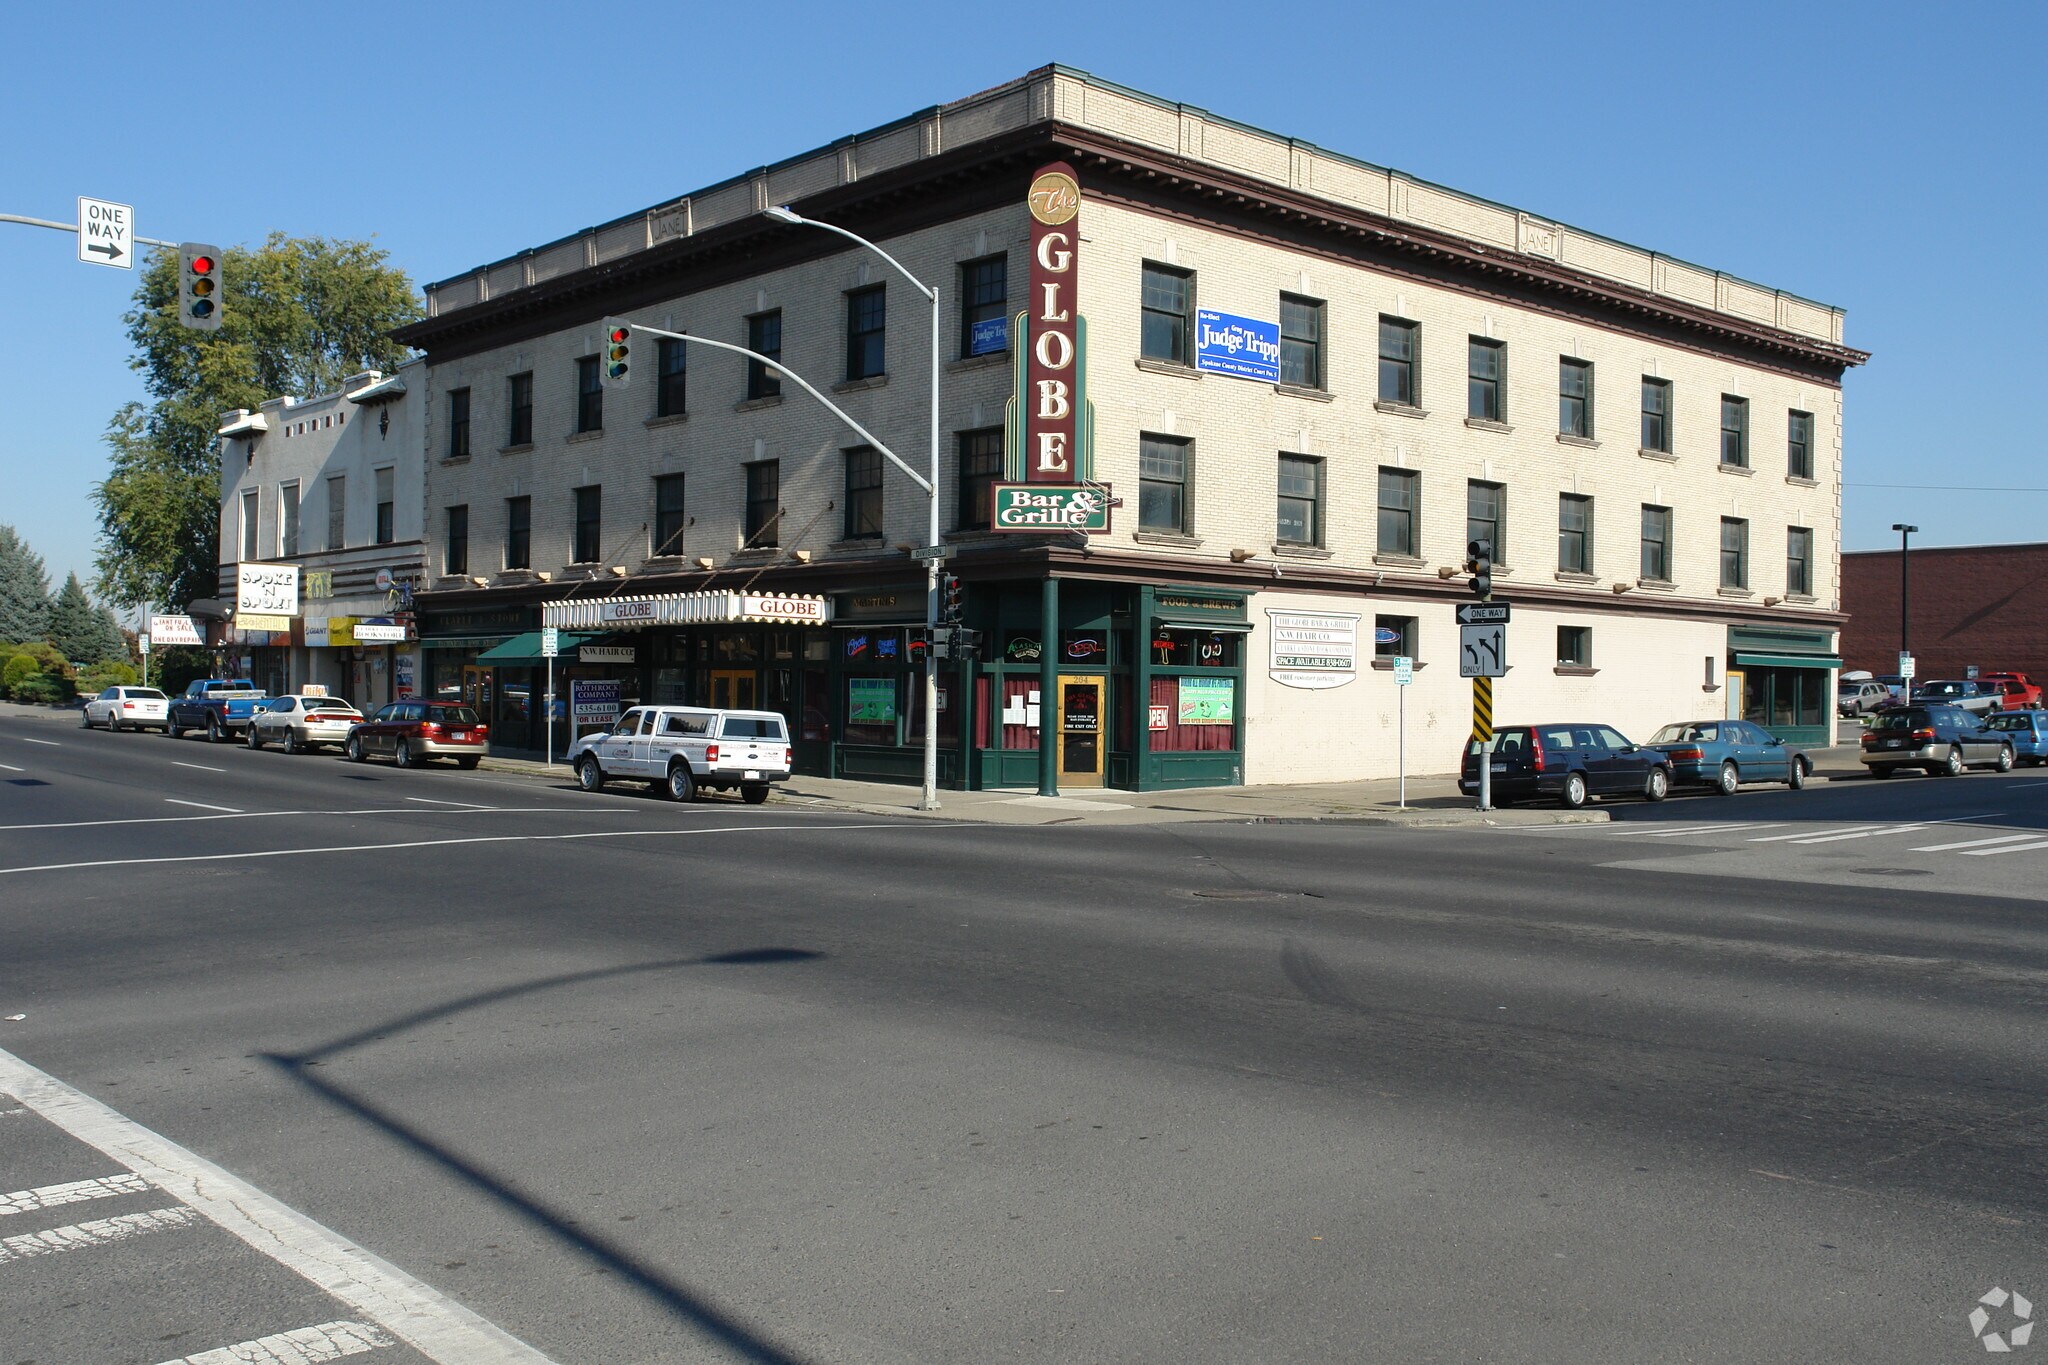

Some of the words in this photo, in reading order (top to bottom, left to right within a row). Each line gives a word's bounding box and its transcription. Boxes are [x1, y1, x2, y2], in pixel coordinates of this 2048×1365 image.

[1031, 187, 1076, 213] The
[89, 205, 124, 224] ONE
[88, 221, 124, 240] WAY
[655, 211, 687, 240] JANET
[1520, 226, 1556, 254] JANET
[1200, 312, 1220, 321] Re-Elect
[973, 329, 994, 344] Judge
[1199, 324, 1243, 354] Judge
[1243, 330, 1278, 363] Tripp
[1036, 232, 1073, 473] GLOBE
[1201, 359, 1221, 367] Spokane
[1222, 362, 1237, 371] County
[1238, 365, 1253, 373] District
[1253, 367, 1266, 375] Court
[1010, 491, 1063, 507] Bar
[1066, 491, 1100, 513] &
[1001, 507, 1087, 524] Grille
[915, 550, 942, 558] DIVISION
[242, 572, 292, 586] SPOKE
[241, 597, 292, 610] SPORT
[615, 603, 651, 617] GLOBE
[760, 600, 817, 615] GLOBE
[1161, 597, 1189, 607] FOOD
[1202, 600, 1237, 610] BREWS
[1471, 609, 1486, 618] ONE
[1488, 609, 1504, 617] WAY
[1279, 617, 1290, 625] THE
[1291, 618, 1310, 627] GLOBE
[1311, 619, 1323, 627] BAR
[1330, 620, 1350, 629] GRILLE
[310, 627, 327, 635] GIANT
[1296, 631, 1317, 640] HAIR
[1068, 643, 1097, 653] OPEN
[1277, 643, 1296, 652] CLARKE
[1301, 645, 1315, 653] STONE
[1276, 657, 1295, 666] SPACE
[1295, 657, 1325, 667] AVAILABLE
[1463, 665, 1480, 674] ONLY
[578, 704, 616, 712] 535-6100
